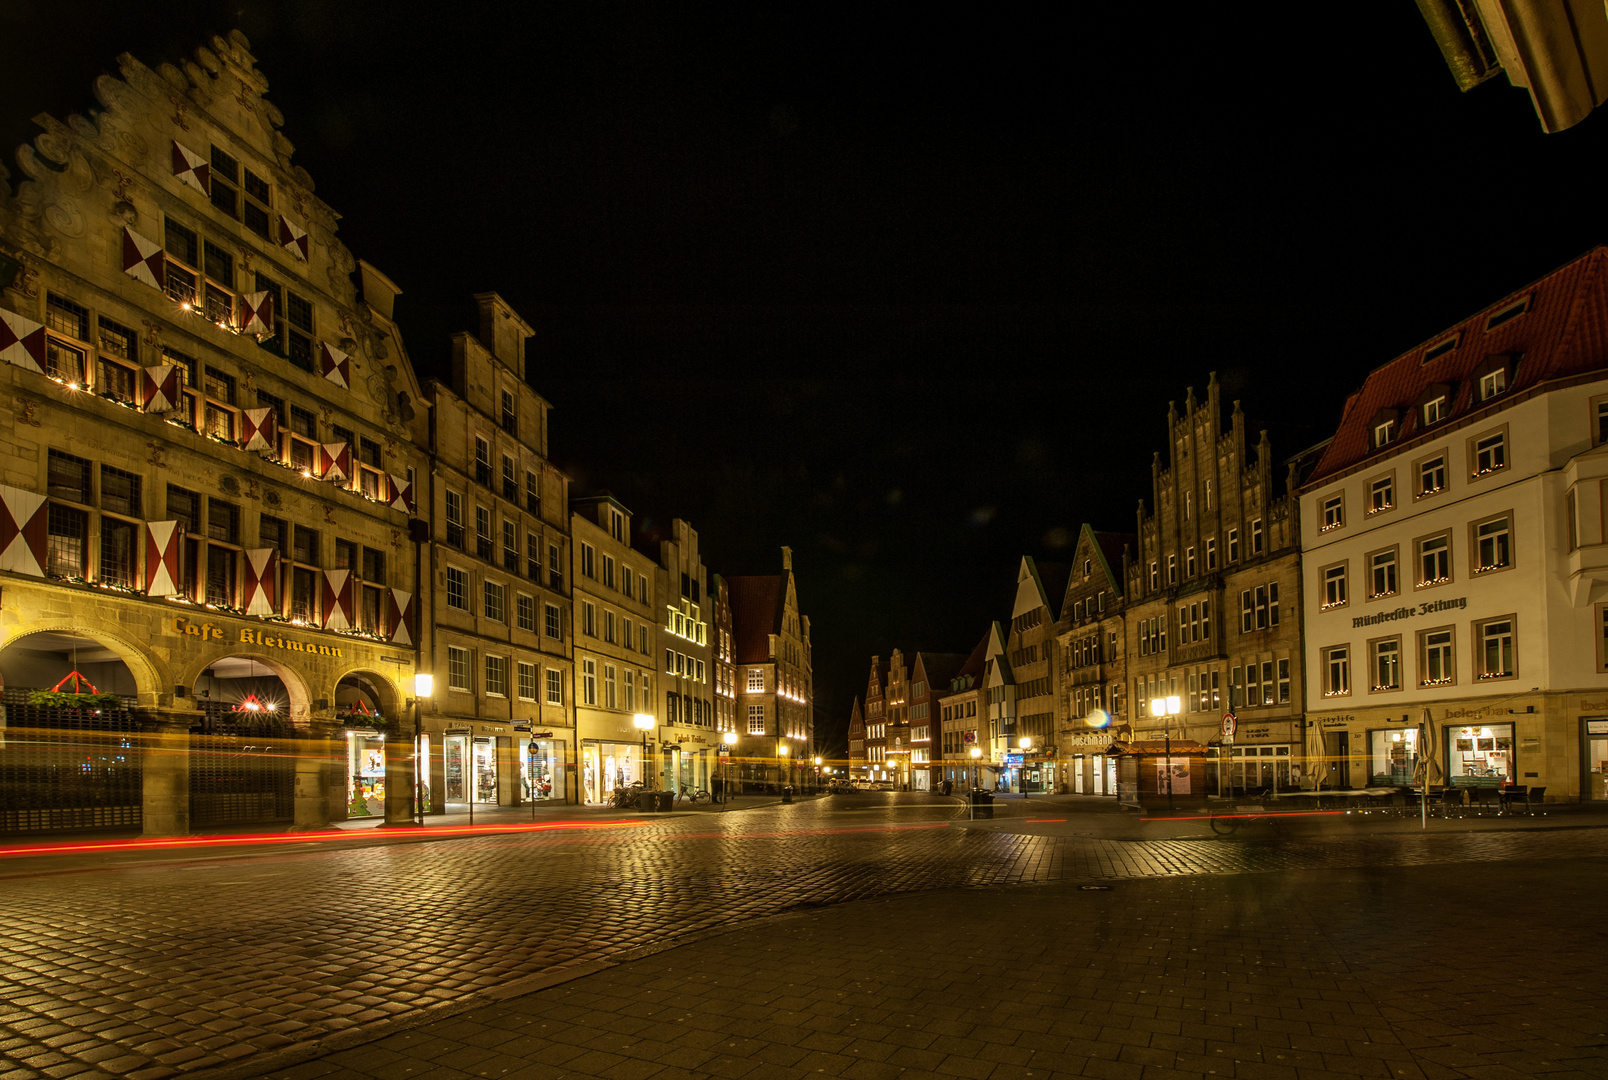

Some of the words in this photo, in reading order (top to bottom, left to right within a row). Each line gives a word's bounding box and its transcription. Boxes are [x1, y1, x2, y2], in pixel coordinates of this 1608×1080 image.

[1418, 597, 1467, 616] Zeitung
[171, 616, 224, 641] Cafe
[240, 628, 343, 658] Kleimann
[1071, 734, 1113, 746] buschmann
